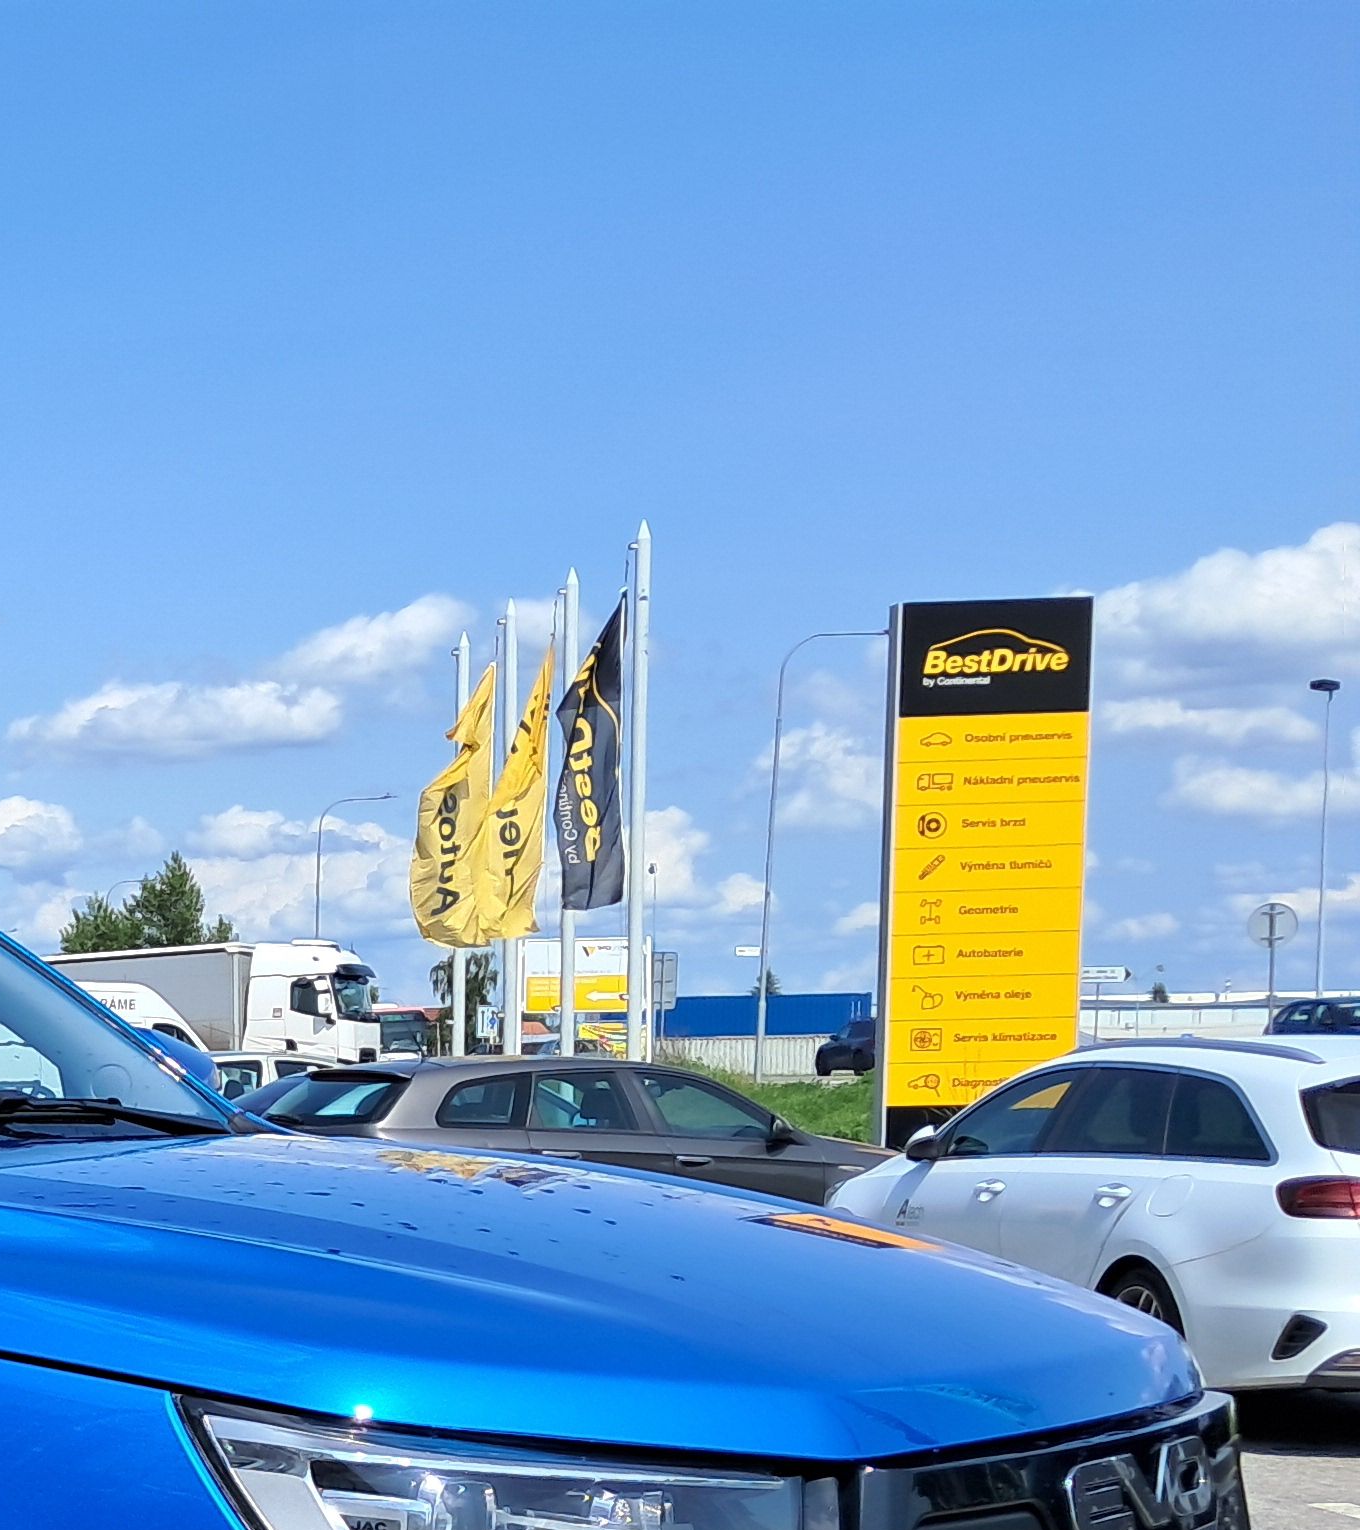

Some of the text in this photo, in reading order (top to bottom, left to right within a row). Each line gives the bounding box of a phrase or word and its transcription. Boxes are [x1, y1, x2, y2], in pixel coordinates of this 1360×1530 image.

[923, 648, 1069, 674] BestDrive
[922, 676, 991, 687] by Continental
[964, 732, 1073, 744] Osobní pneuservis
[963, 774, 1080, 786] Nákladní pneuservis
[961, 817, 1026, 828] Servis brzd
[960, 859, 1052, 872] Výměna tlumičů
[958, 905, 1019, 916] Geometrie
[956, 948, 1024, 959] Autobaterie
[955, 989, 1032, 1001] Výměna oleje
[953, 1031, 1057, 1042] Servis klimatizace
